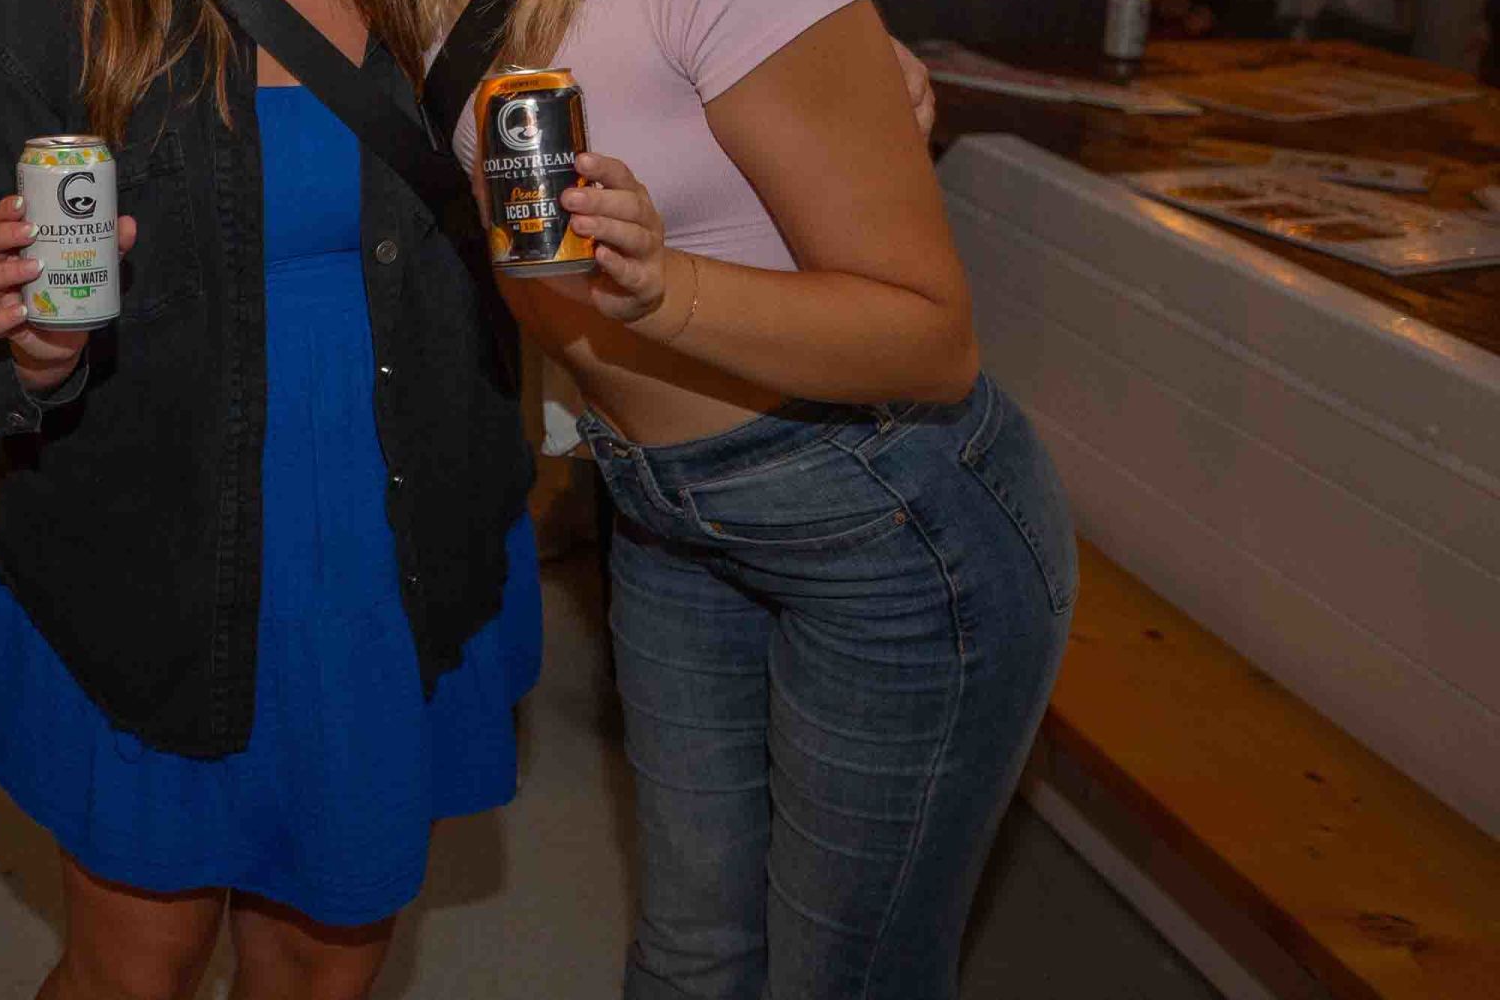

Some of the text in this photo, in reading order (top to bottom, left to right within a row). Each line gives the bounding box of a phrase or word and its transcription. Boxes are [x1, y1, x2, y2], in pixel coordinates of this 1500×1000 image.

[483, 152, 575, 172] COLDSTREAM
[504, 169, 547, 179] CLEAR
[506, 202, 557, 219] ICED TEA
[59, 236, 97, 245] CLEAR
[67, 259, 92, 268] LIME
[48, 269, 109, 285] VODKA WATER
